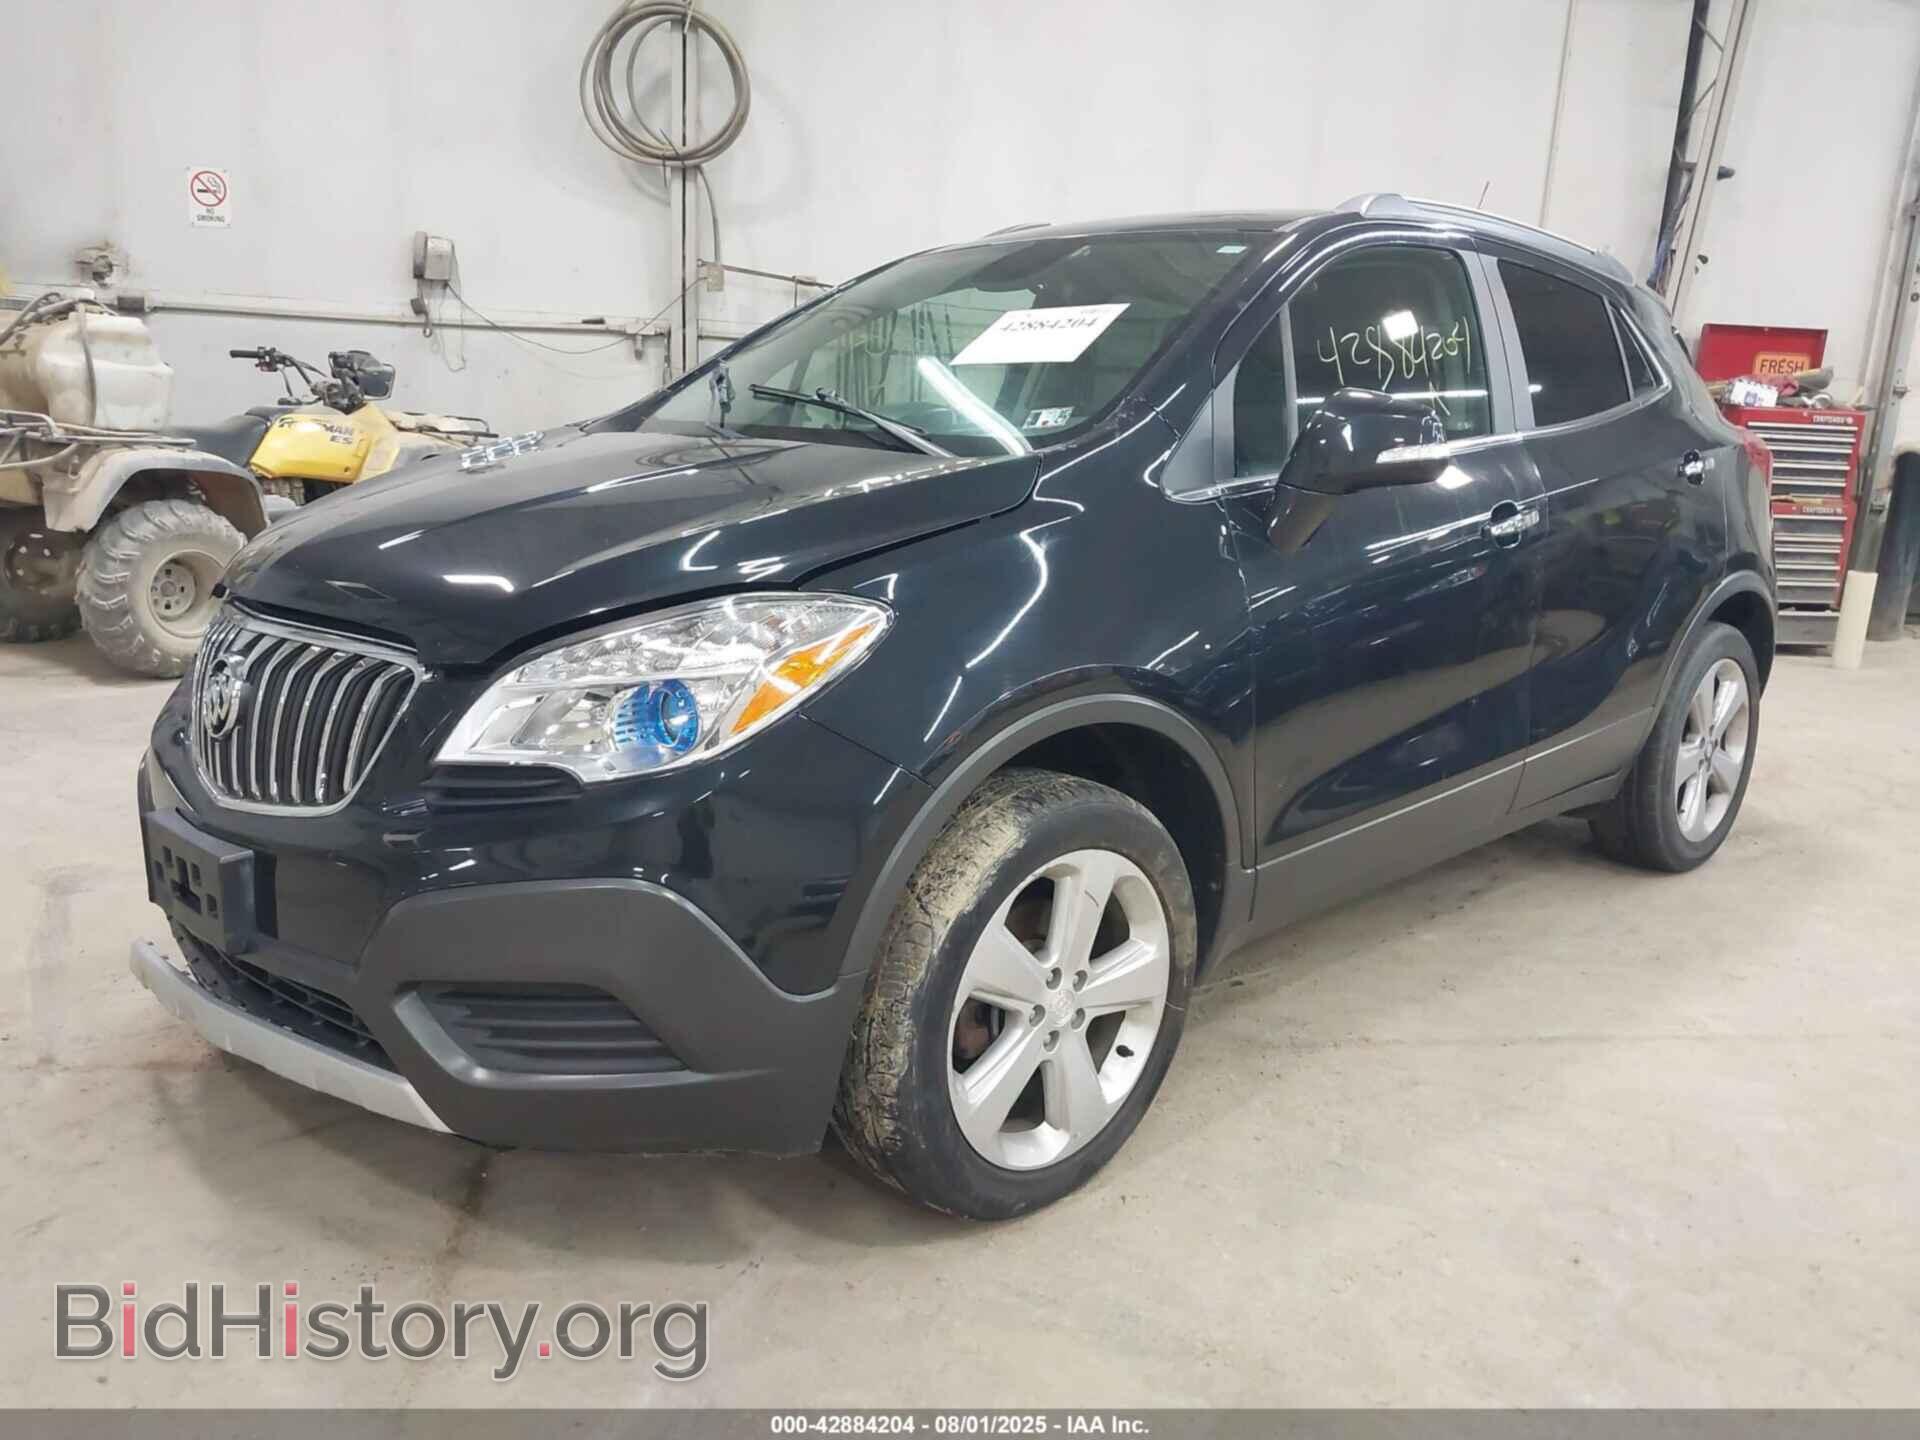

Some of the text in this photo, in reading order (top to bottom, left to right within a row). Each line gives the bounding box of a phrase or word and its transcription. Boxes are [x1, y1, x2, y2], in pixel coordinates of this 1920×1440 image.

[196, 214, 225, 223] SMOKING
[1001, 317, 1097, 332] 42884204
[1759, 359, 1805, 374] FRESH
